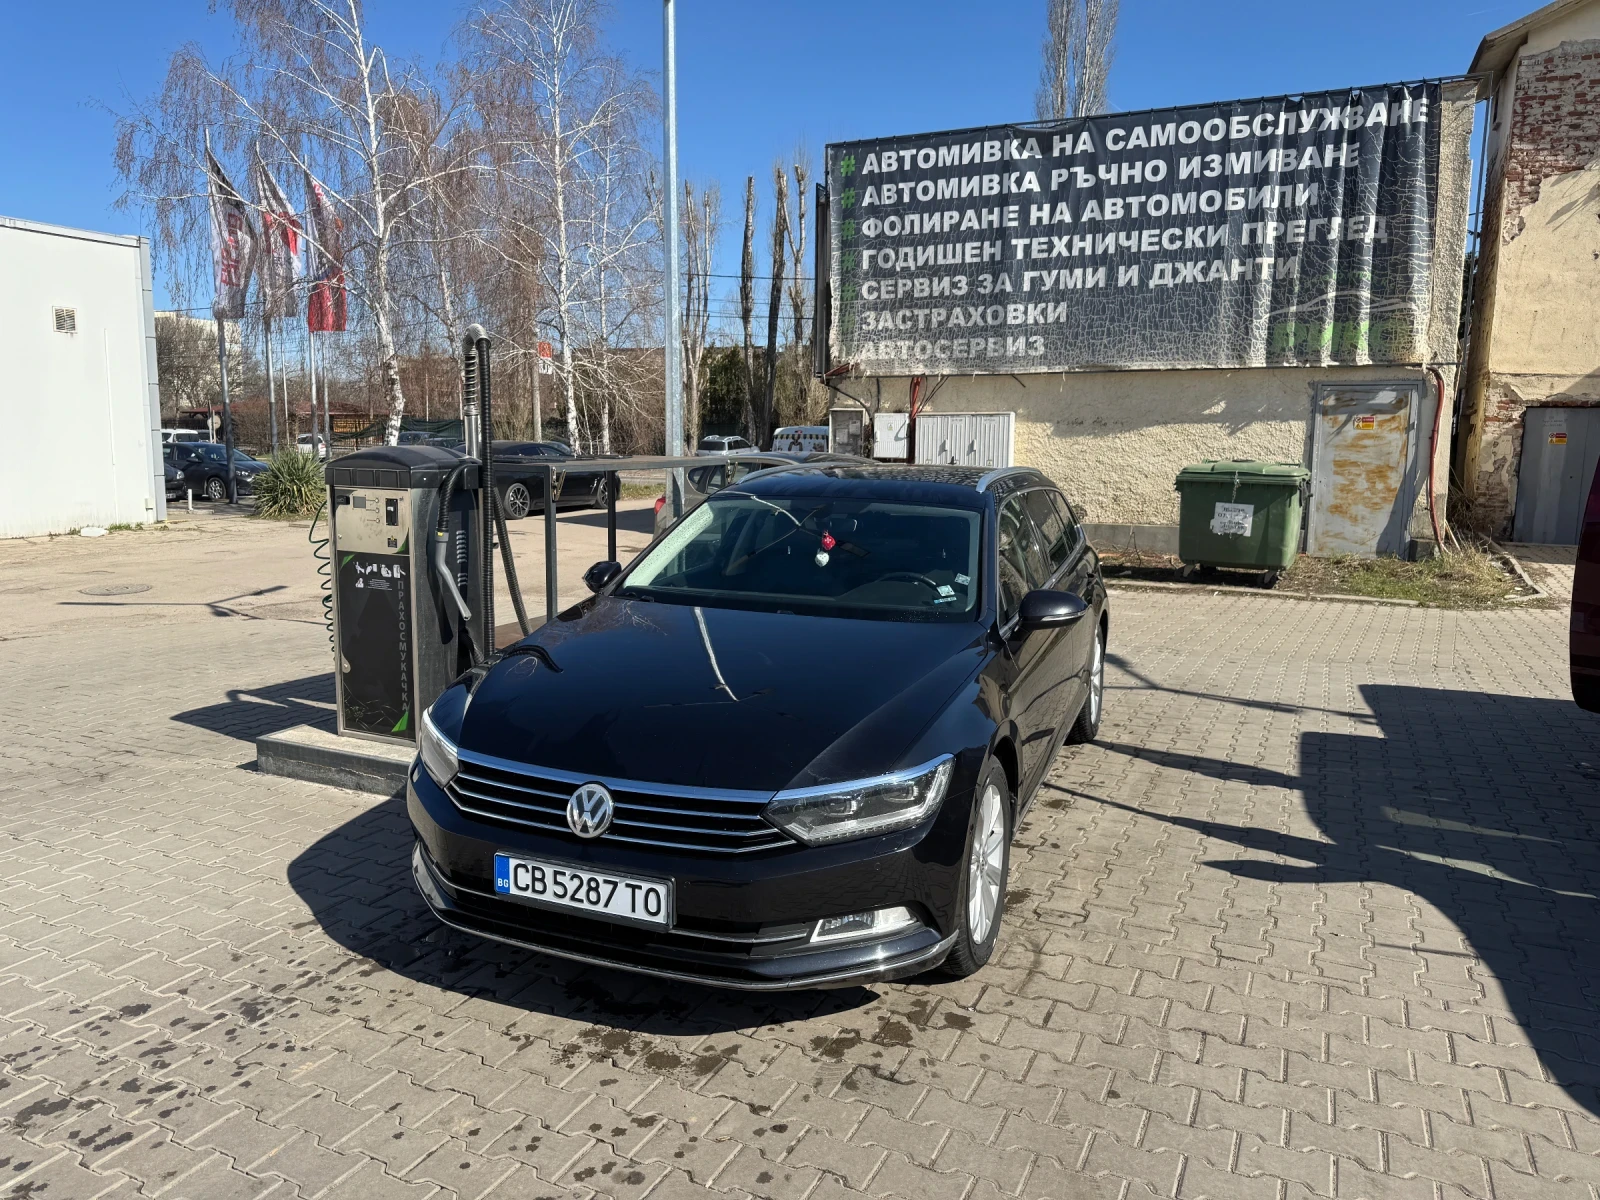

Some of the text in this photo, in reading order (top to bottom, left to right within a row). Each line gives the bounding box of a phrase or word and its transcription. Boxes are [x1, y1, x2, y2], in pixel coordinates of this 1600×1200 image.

[841, 98, 1430, 177] # АВТОМИВКА НА САМООБСЛУЖВАНЕ
[841, 142, 1360, 208] # АВТОМИВКА РЪЧНО ИЗМИВАНЕ
[841, 182, 1319, 240] # ФОЛИРАНЕ НА АВТОМОБИЛИ
[862, 241, 1001, 272] ГОДИШЕН
[1010, 223, 1229, 260] ТЕХНИЧЕСКИ
[1241, 214, 1388, 246] ПРЕГЛЕД
[861, 275, 968, 301] СЕРВИЗ
[977, 272, 1013, 294] ЗА
[1023, 266, 1106, 292] ГУМИ
[1117, 264, 1140, 288] И
[1149, 255, 1297, 289] ДЖАНТИ
[861, 302, 1067, 331] ЗАСТРАХОВКИ
[862, 335, 1045, 360] АВТОСЕРВИЗ
[397, 580, 408, 711] ПРАХОСМУКАЧКА
[497, 878, 509, 888] BG
[513, 863, 662, 917] CB 5287 TO
